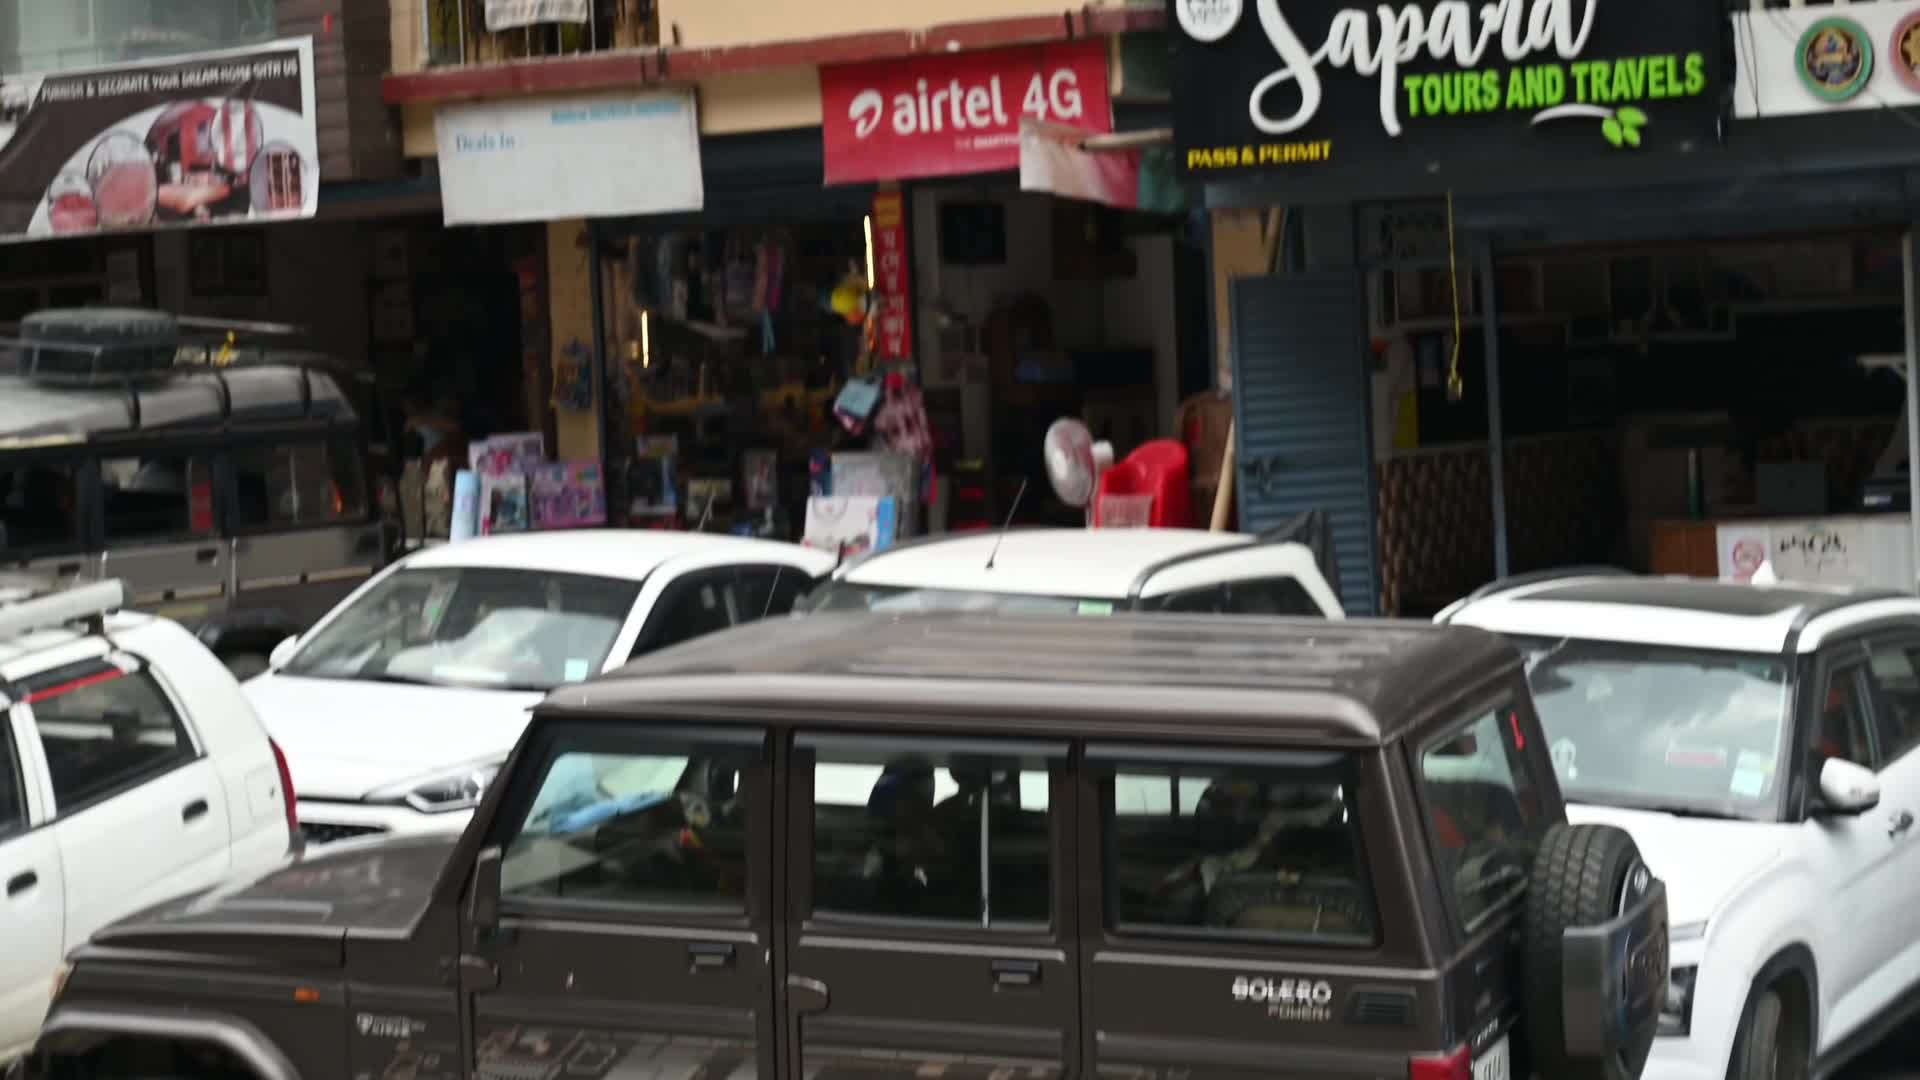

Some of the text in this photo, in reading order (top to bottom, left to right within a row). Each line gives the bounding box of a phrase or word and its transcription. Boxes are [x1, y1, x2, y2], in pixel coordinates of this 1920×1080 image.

[98, 76, 150, 97] DECORATE
[151, 72, 180, 91] YOUR
[181, 66, 219, 88] DREAM
[219, 63, 251, 83] HOME
[252, 60, 281, 80] WITH
[282, 58, 299, 77] US
[1403, 51, 1706, 117] TOURS AND TRAVELS
[892, 68, 1083, 136] airtel 4G
[1187, 139, 1332, 169] PASS & PERMIT
[1232, 976, 1332, 1008] BOLERO
